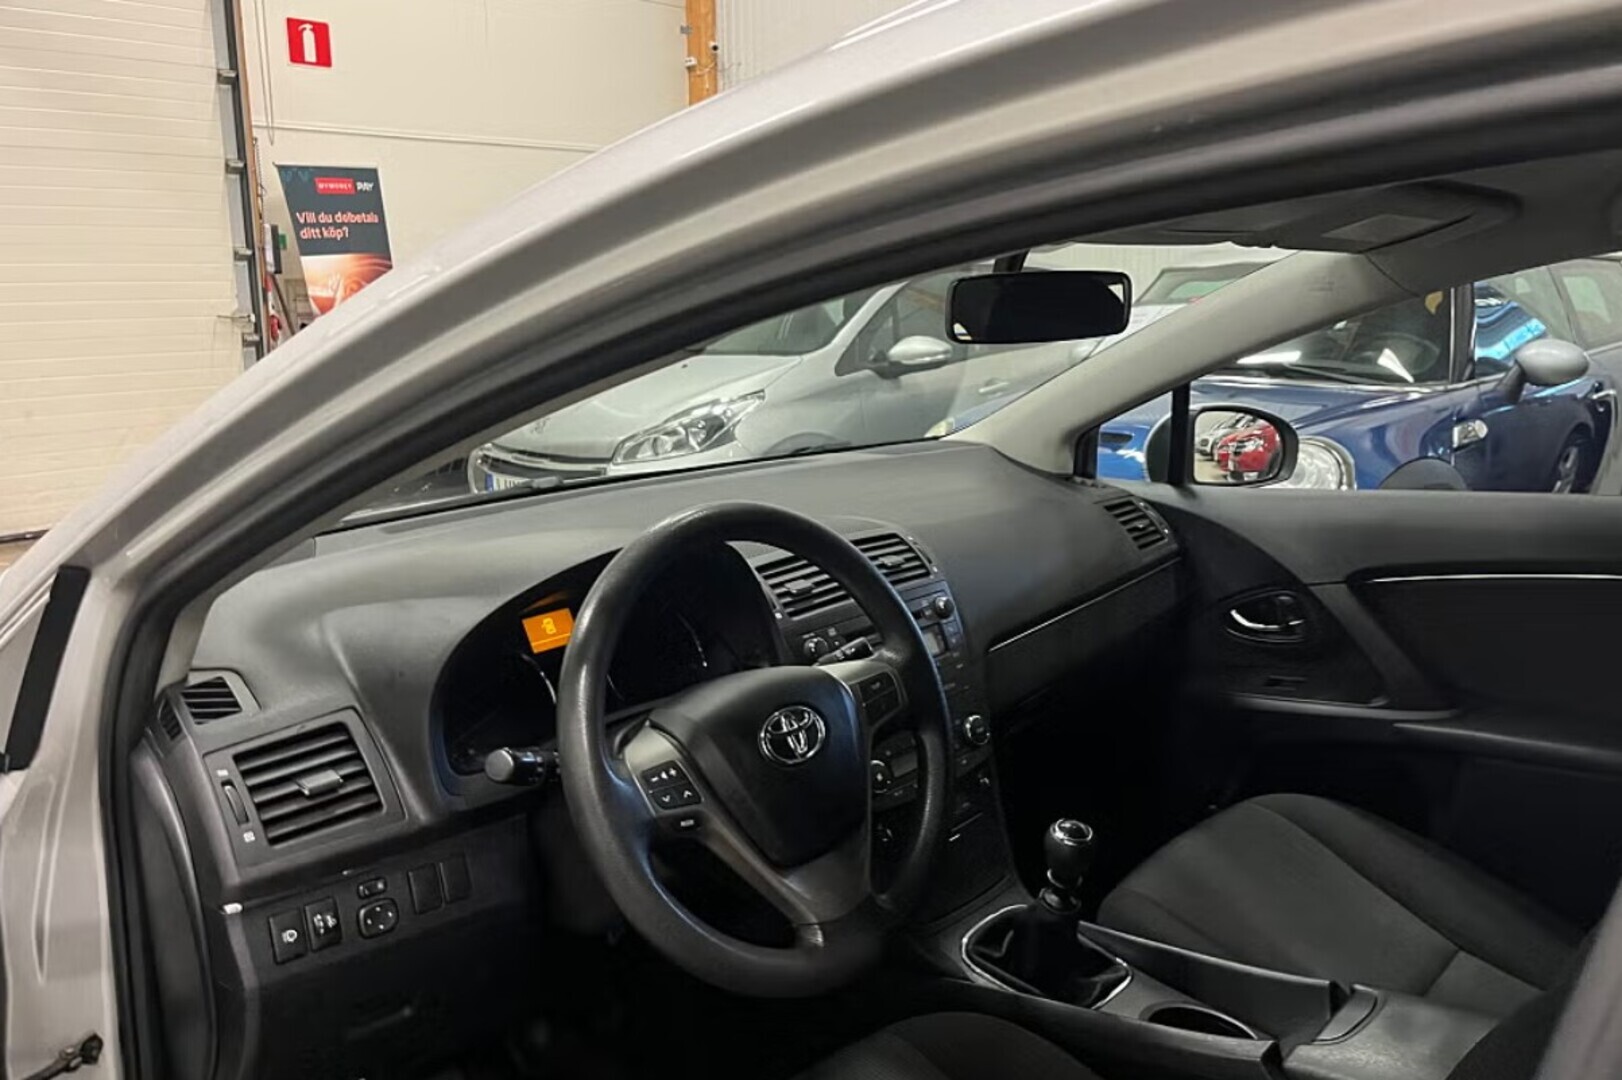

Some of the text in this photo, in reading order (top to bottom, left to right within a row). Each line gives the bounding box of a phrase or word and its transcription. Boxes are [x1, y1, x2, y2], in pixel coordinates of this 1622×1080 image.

[356, 181, 374, 191] PAY
[296, 211, 316, 224] Vill
[317, 212, 333, 223] du
[300, 226, 349, 241] ditt köp?
